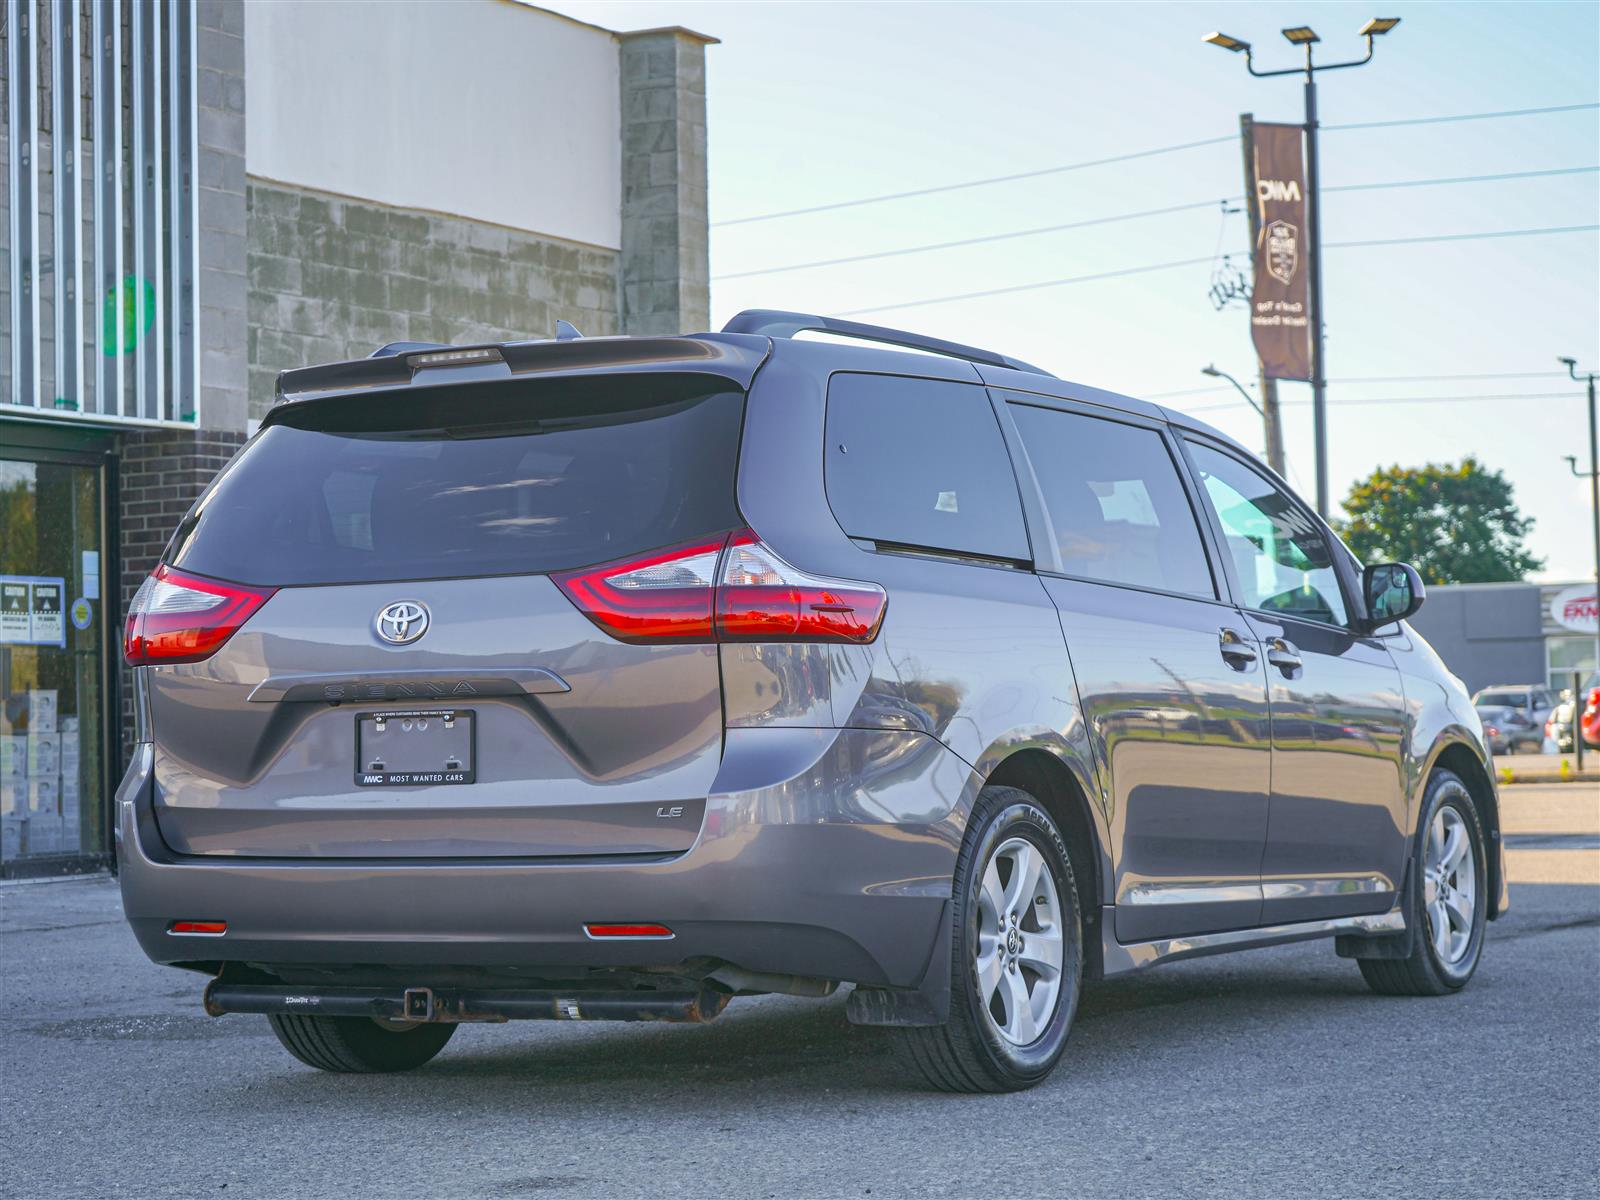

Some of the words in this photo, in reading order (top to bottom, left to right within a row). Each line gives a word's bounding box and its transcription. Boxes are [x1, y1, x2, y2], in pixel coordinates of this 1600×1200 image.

[324, 680, 478, 698] SIENNA
[389, 775, 410, 783] MOST
[412, 774, 443, 782] WANTED
[655, 806, 684, 818] LE
